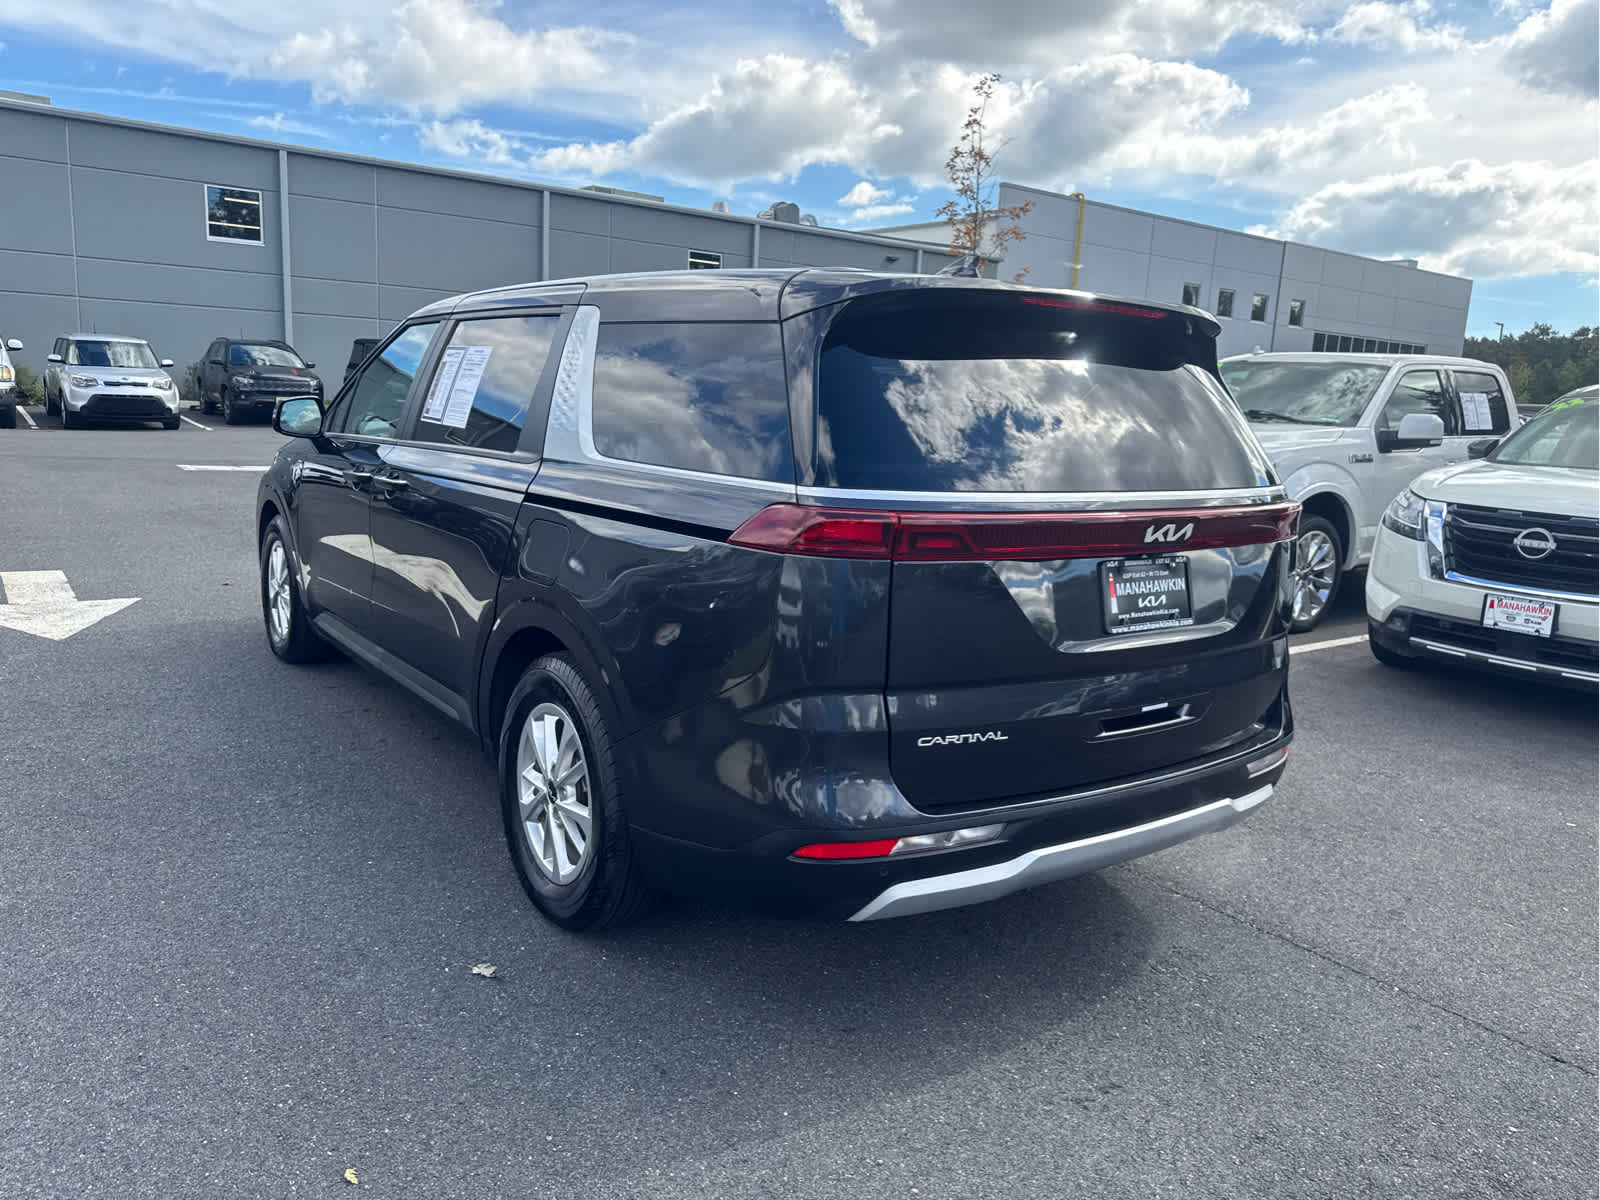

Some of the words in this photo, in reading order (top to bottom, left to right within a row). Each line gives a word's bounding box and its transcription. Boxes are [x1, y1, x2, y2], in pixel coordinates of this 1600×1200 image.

[1116, 577, 1186, 596] MANAHAWKIN
[1496, 600, 1552, 616] MANAHAWKIN
[917, 731, 1009, 747] CARNIVAL
